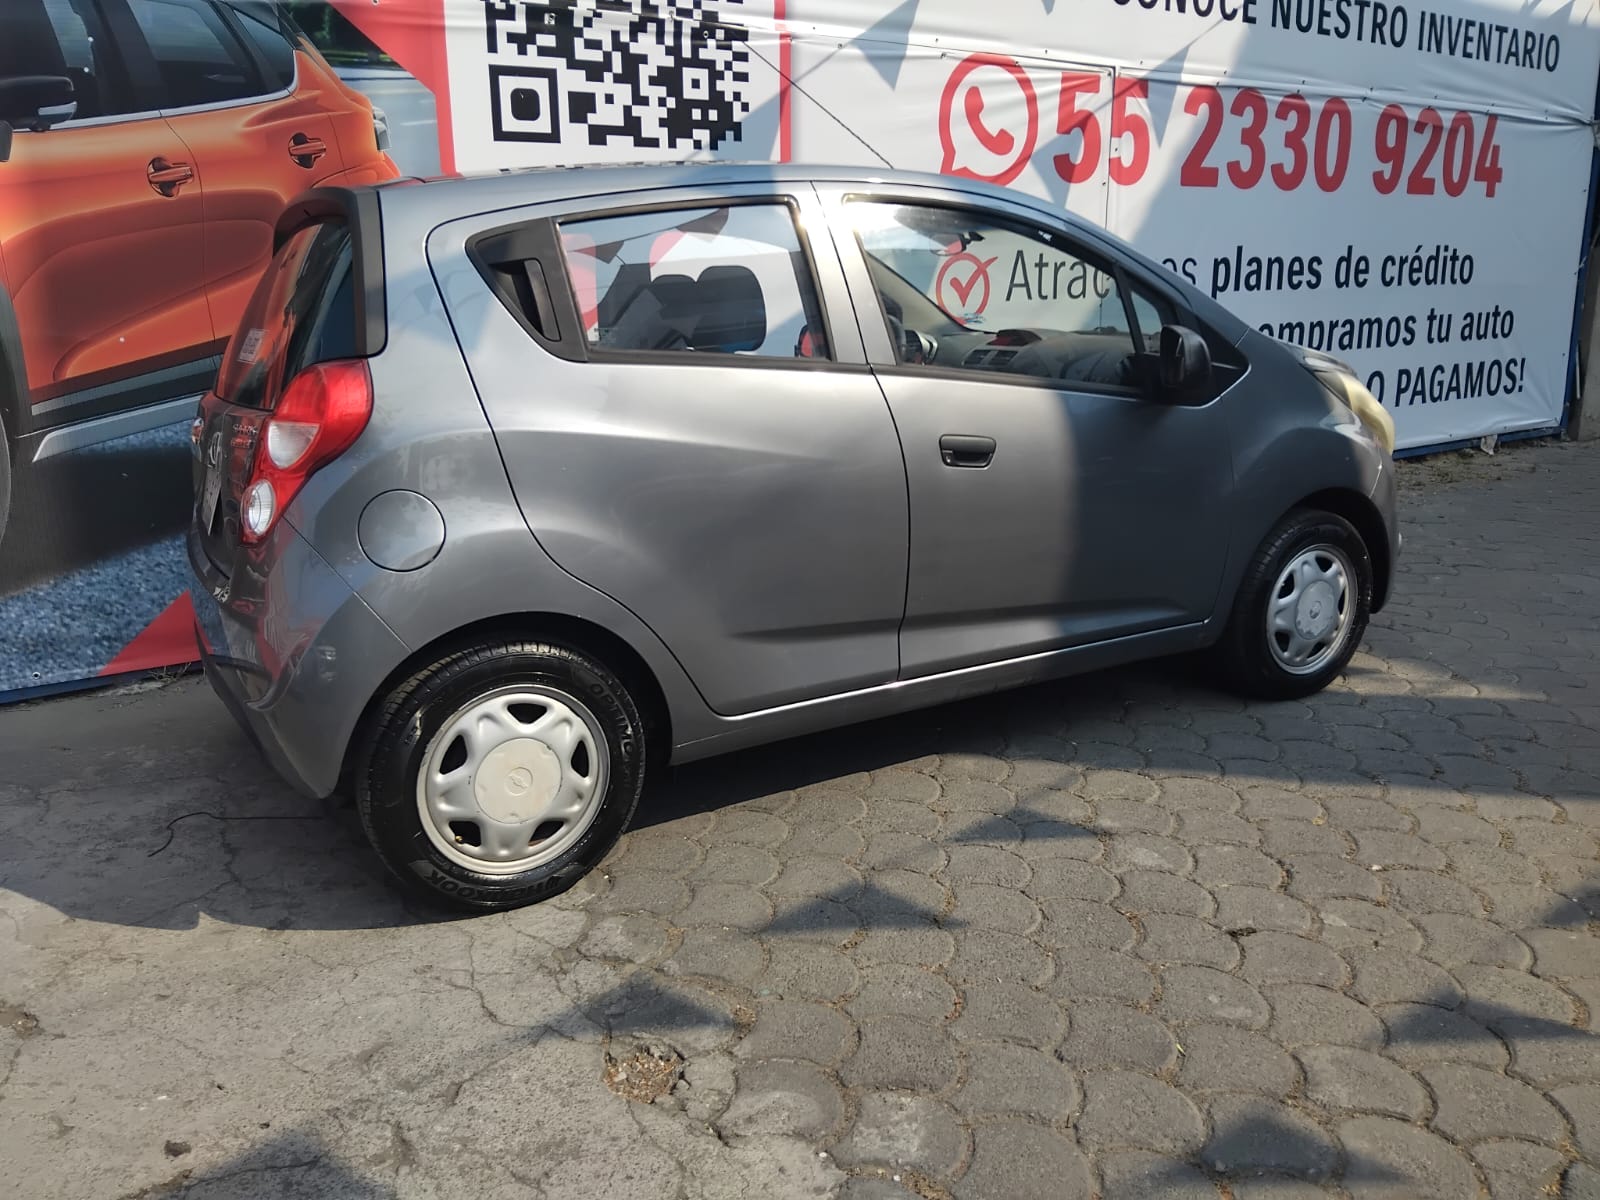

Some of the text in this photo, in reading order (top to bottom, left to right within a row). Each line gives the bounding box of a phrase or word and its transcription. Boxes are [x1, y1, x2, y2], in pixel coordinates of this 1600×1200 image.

[1271, 0, 1408, 48] NUESTRO
[1417, 10, 1561, 73] INVENTARIO
[1053, 71, 1503, 198] 55 2330 9204
[1211, 245, 1323, 300] planes
[1334, 245, 1370, 288] de
[1381, 245, 1474, 287] crédito
[1427, 307, 1452, 345] tu
[1460, 305, 1515, 342] auto
[1394, 358, 1526, 407] PAGAMOS!
